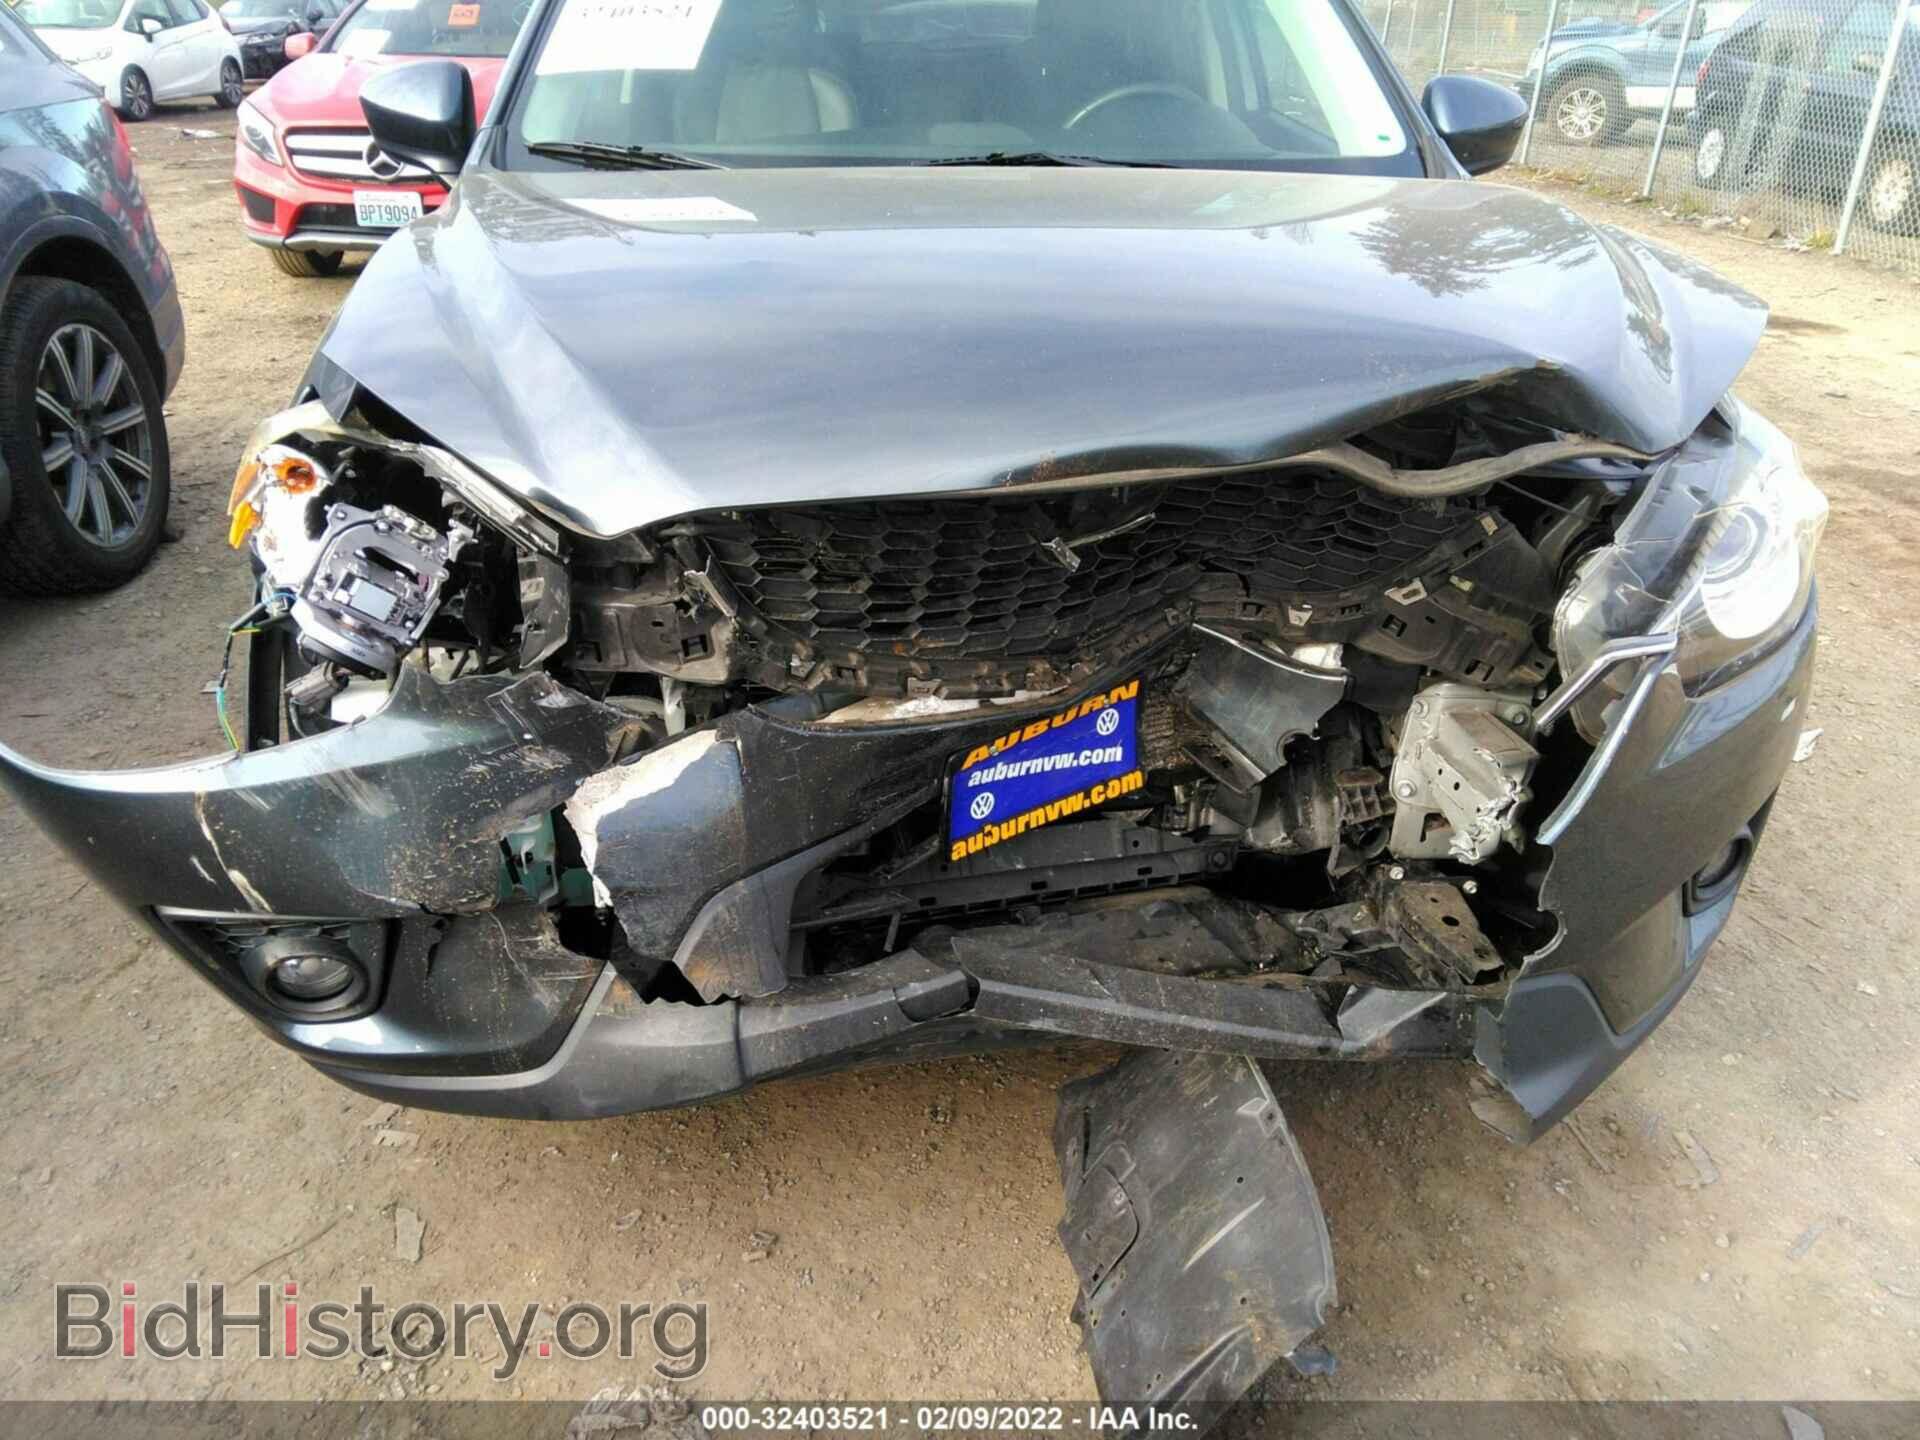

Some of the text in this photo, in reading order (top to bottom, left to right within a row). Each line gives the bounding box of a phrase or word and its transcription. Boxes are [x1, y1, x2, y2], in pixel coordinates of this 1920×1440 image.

[961, 680, 1140, 770] AUBURN
[968, 745, 1123, 787] auburnvw.com
[951, 769, 1144, 861] auburnvw.com
